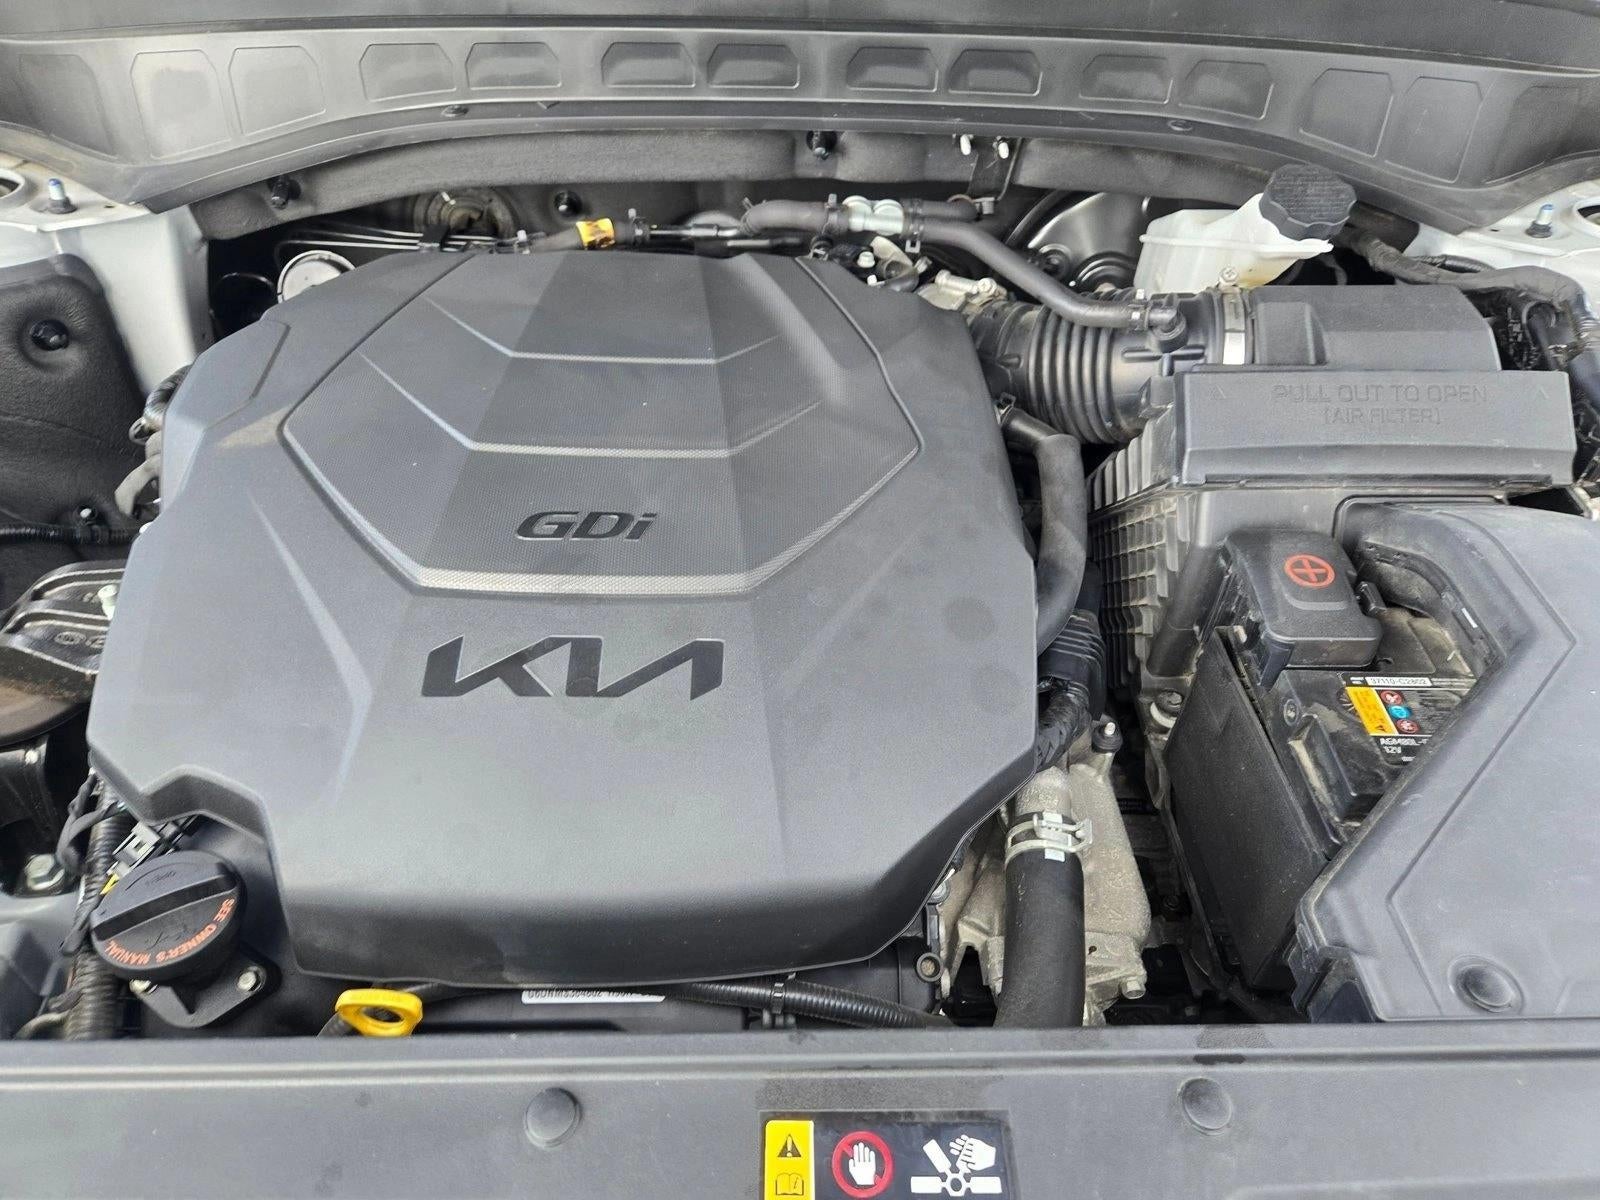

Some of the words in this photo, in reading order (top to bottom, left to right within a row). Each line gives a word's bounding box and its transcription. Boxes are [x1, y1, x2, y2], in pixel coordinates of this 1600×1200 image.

[1272, 384, 1331, 402] PULL
[1337, 384, 1383, 402] OUT
[1390, 384, 1420, 402] TO
[1427, 384, 1488, 402] OPEN
[516, 511, 657, 540] GDi
[421, 635, 724, 701] KIA
[213, 898, 235, 922] SEE
[104, 938, 151, 966] MANUAL
[155, 922, 217, 963] OWNER'S
